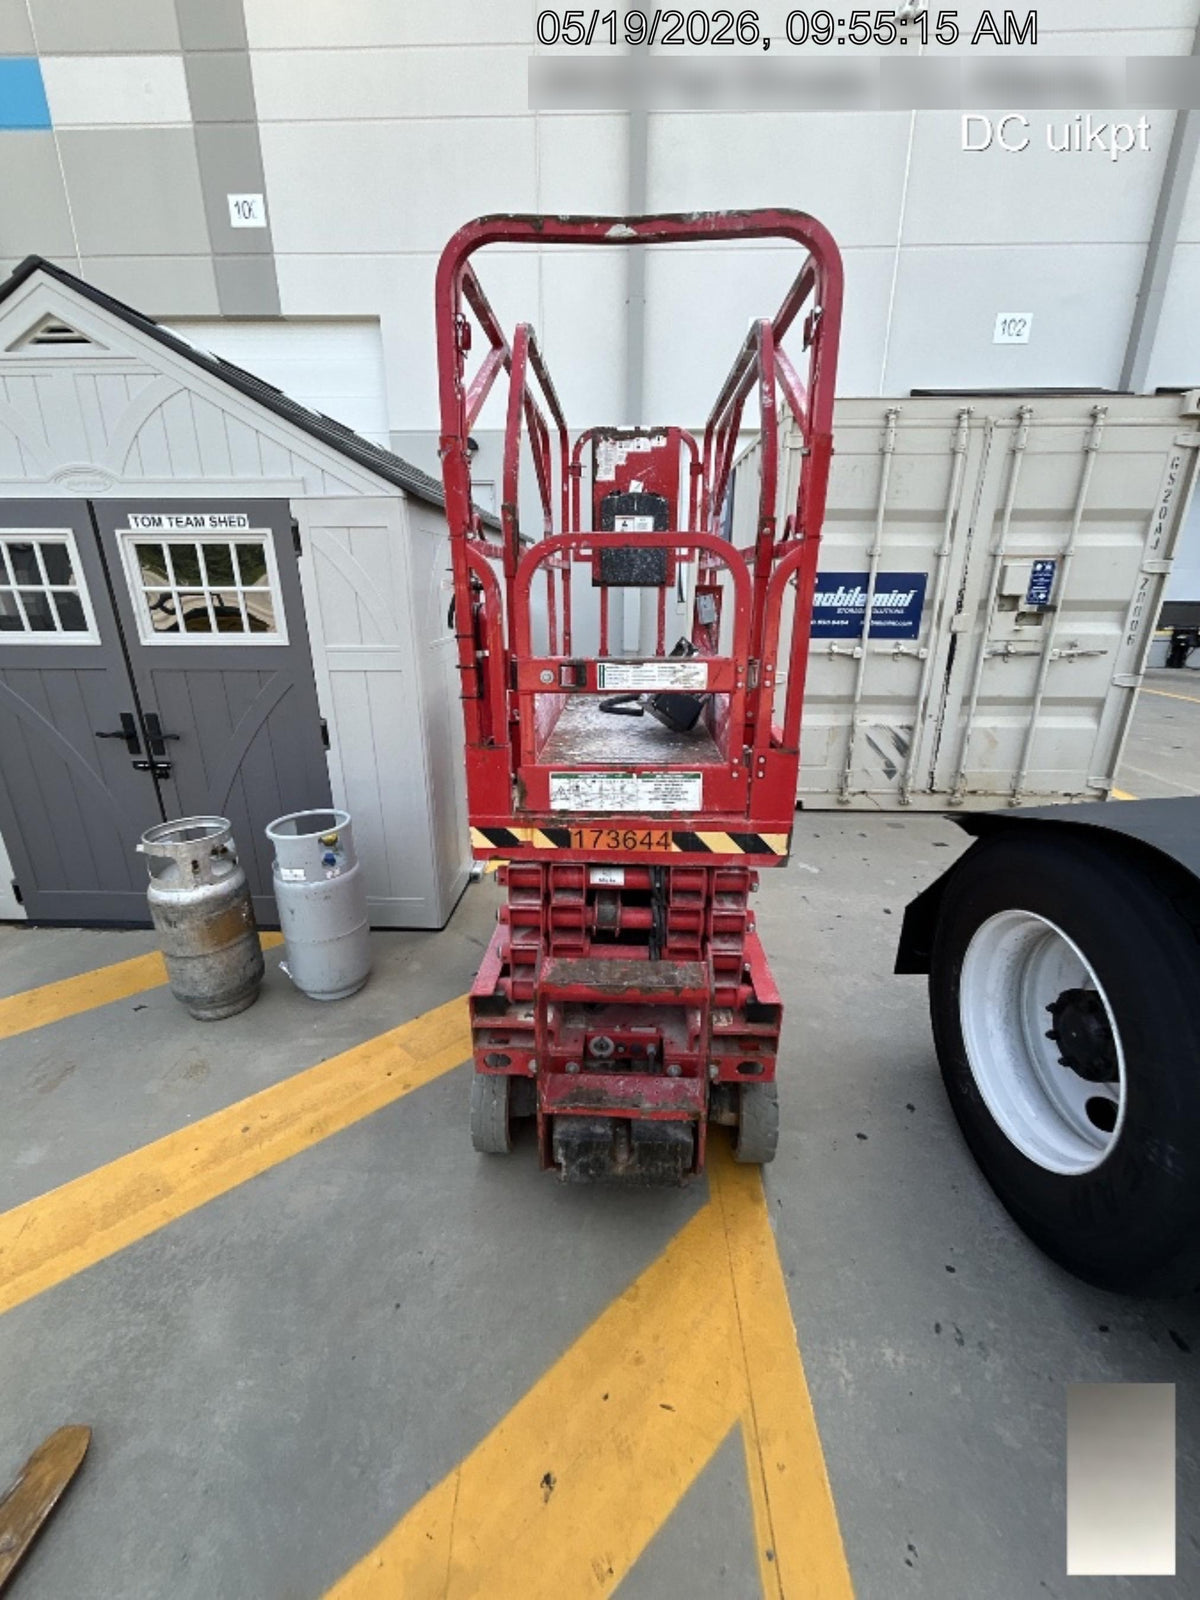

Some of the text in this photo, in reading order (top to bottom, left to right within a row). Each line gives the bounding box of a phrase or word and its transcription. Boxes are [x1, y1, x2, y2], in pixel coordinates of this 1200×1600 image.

[1001, 318, 1027, 336] 102
[133, 515, 247, 528] TOM TEAM SHED
[871, 589, 918, 607] mini
[574, 829, 671, 851] 173644
